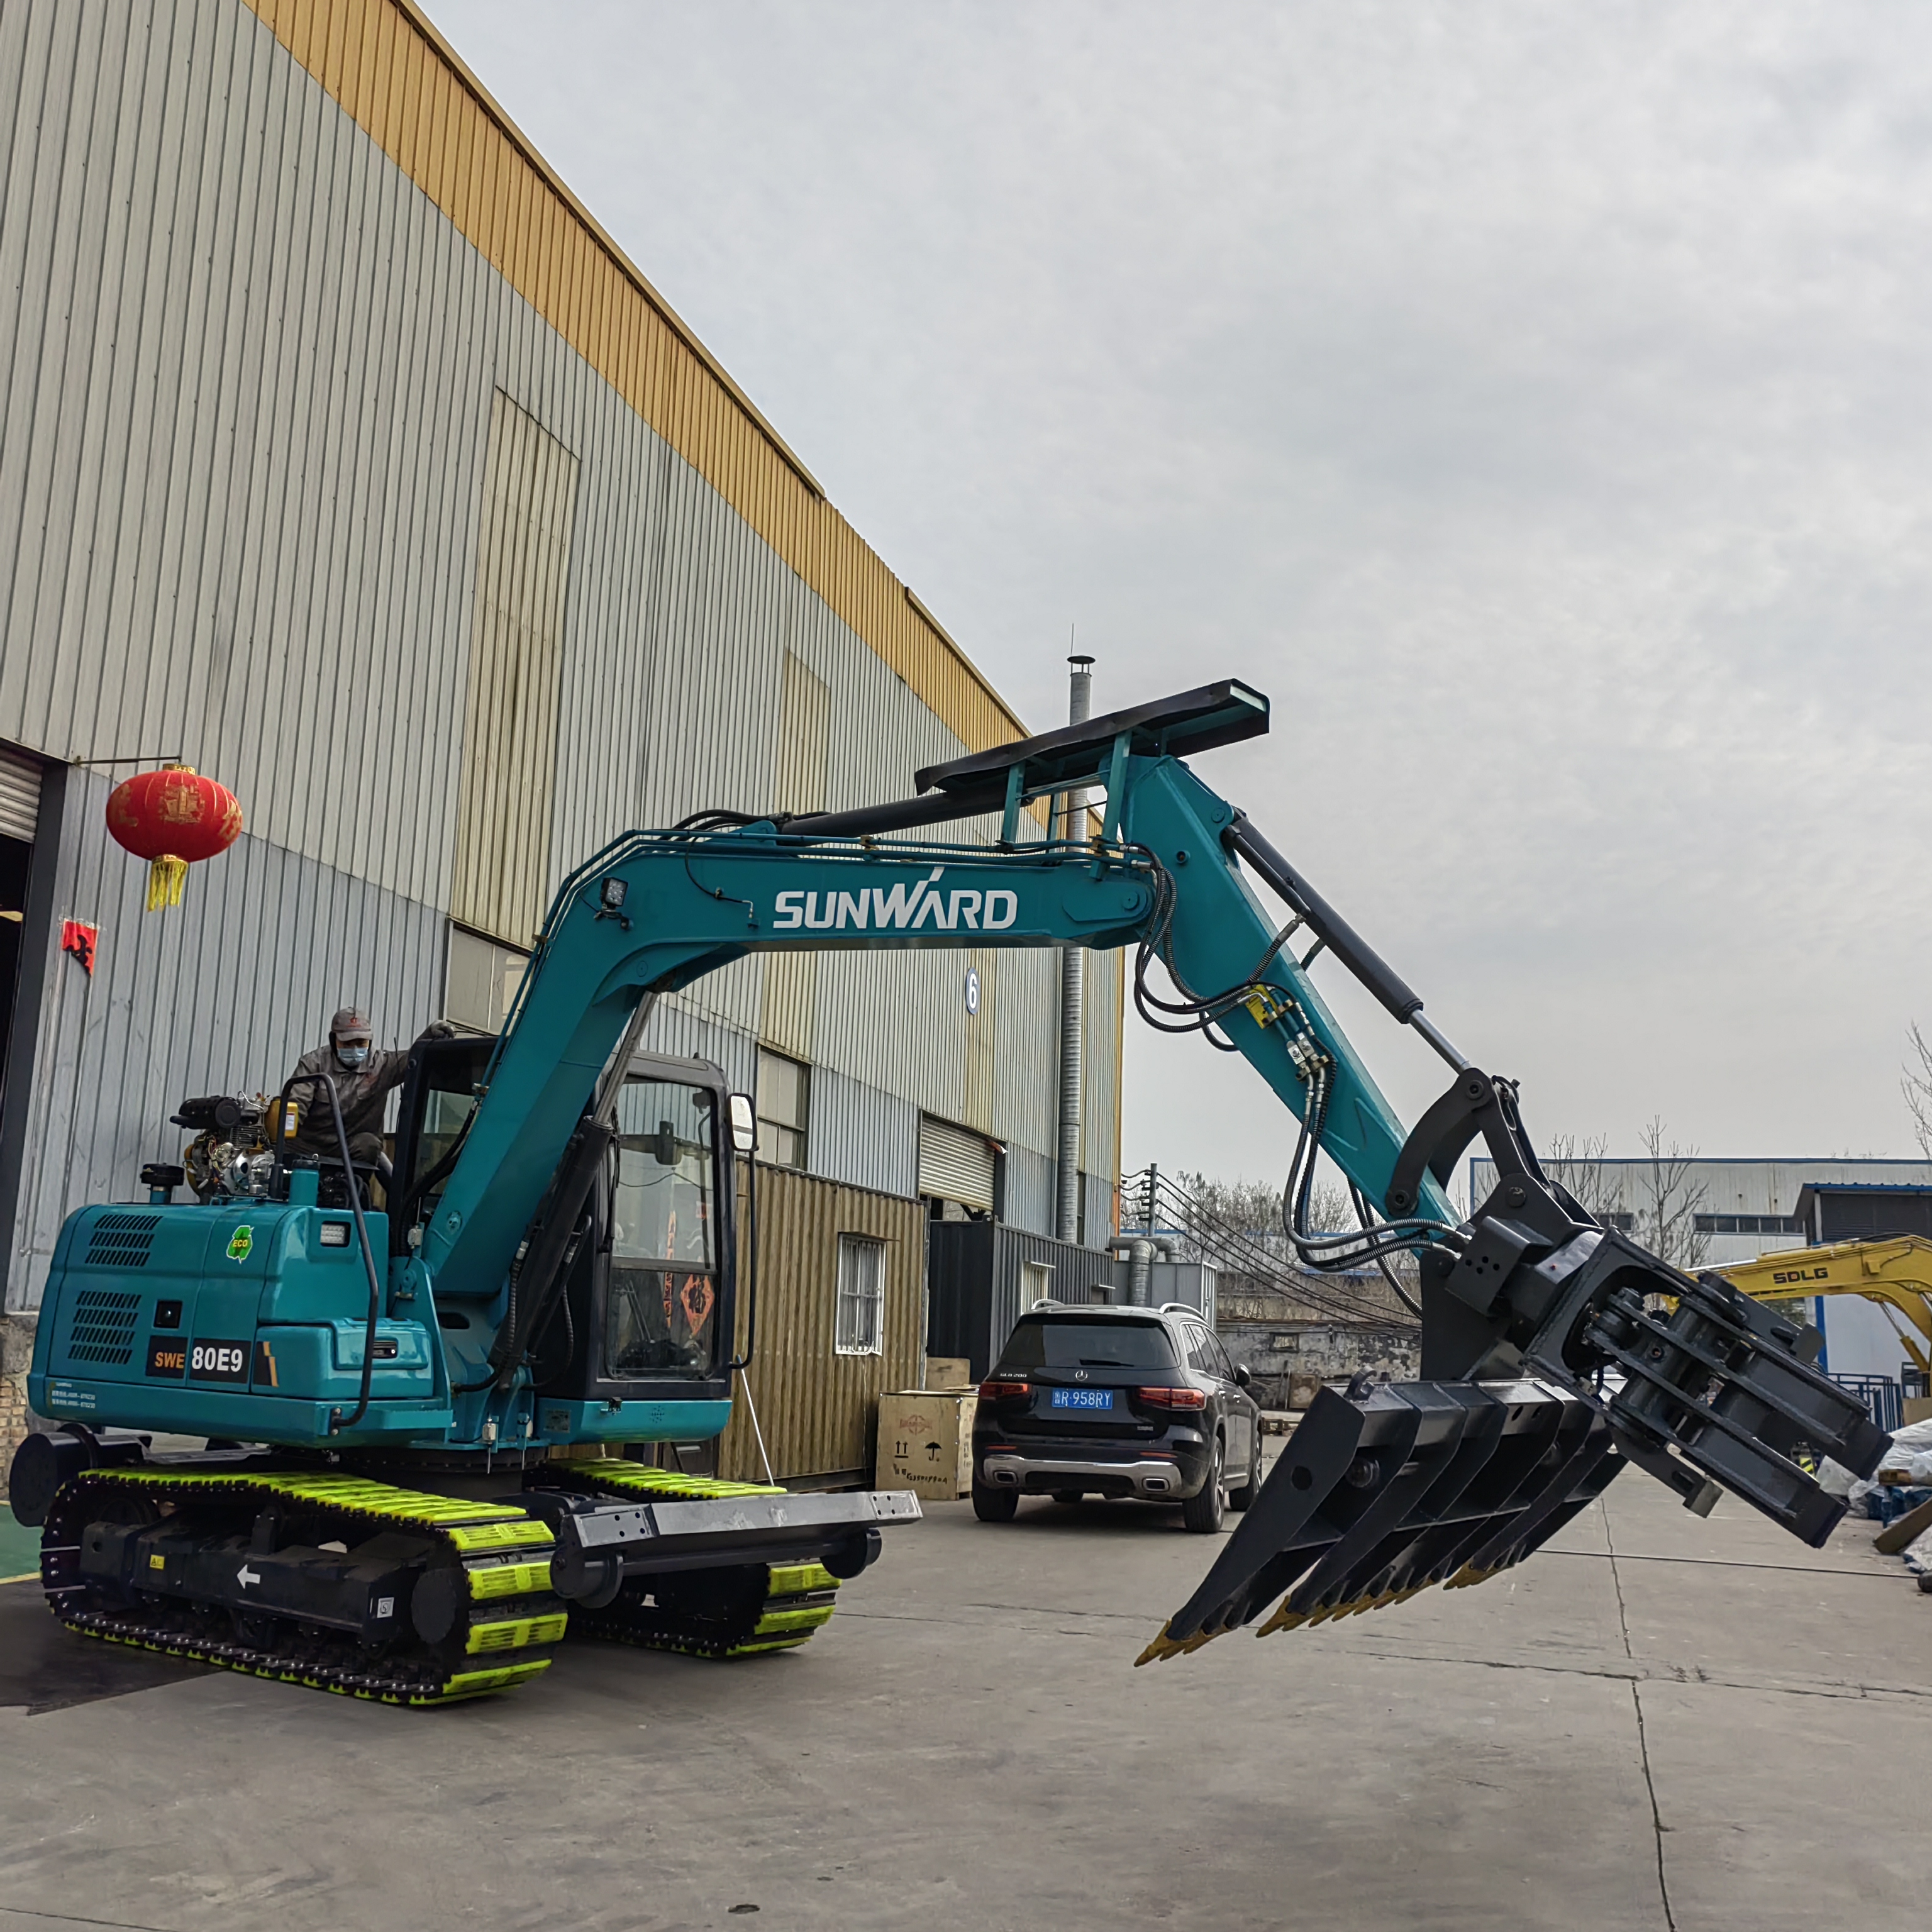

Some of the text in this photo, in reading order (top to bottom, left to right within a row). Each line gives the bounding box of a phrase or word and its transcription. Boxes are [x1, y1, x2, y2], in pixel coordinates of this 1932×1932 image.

[773, 867, 1018, 929] SUNWARD
[968, 972, 978, 1009] 6
[1773, 1267, 1828, 1284] SDLG
[155, 1346, 243, 1372] SWE 80E9
